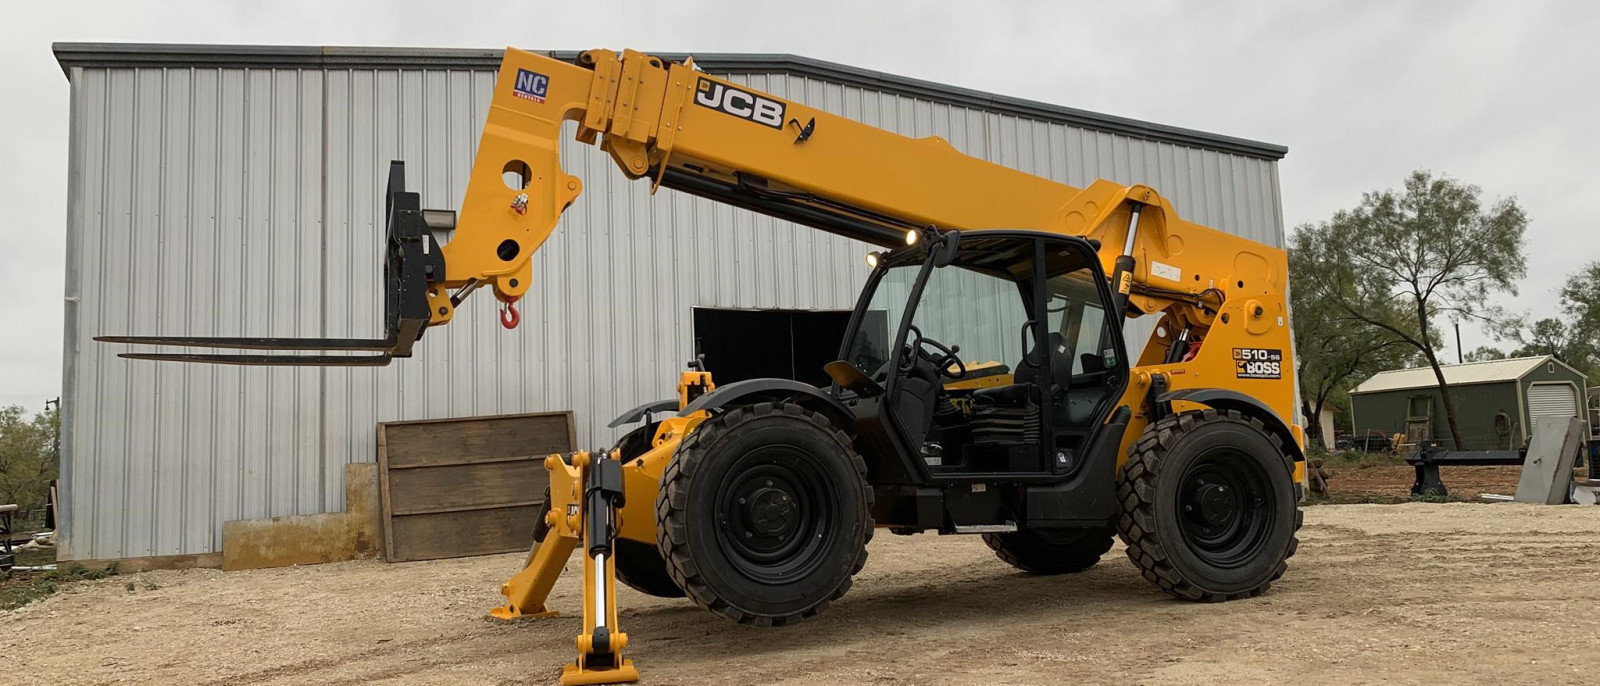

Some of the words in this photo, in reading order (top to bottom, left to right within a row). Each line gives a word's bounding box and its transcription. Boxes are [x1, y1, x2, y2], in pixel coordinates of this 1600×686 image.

[517, 71, 547, 95] NC
[697, 84, 783, 127] JCB
[1246, 361, 1280, 374] BOSS
